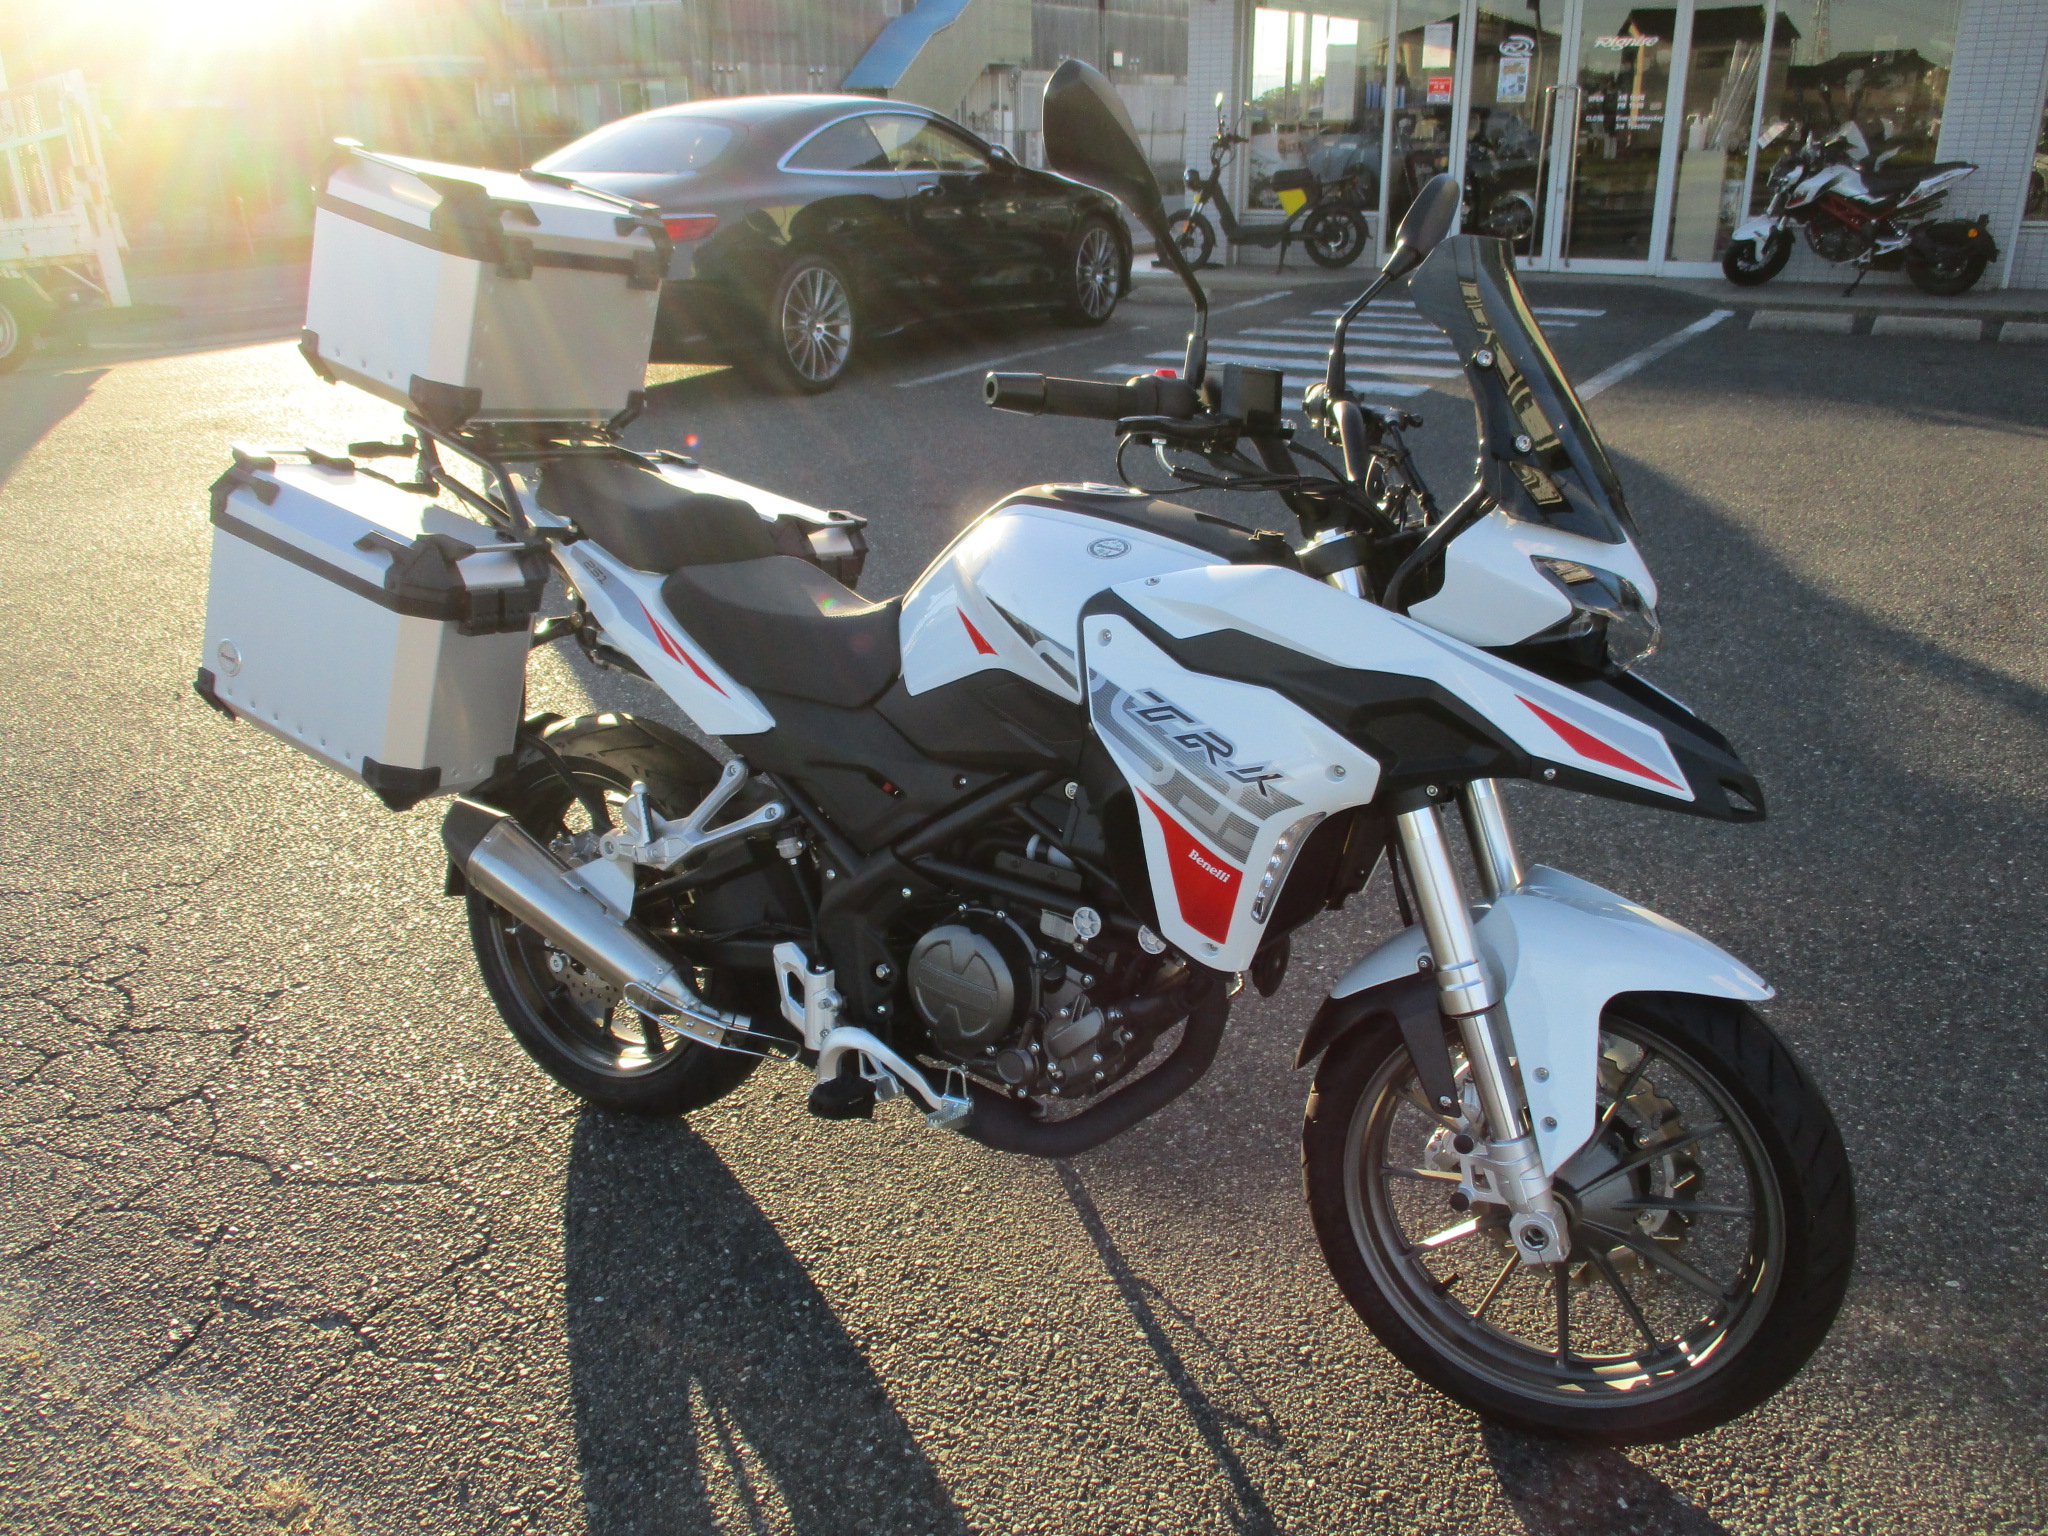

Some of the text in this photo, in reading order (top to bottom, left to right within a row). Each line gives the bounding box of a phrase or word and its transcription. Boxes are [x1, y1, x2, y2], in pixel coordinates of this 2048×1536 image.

[1588, 95, 1604, 103] OPEN
[583, 559, 608, 585] 251
[1136, 690, 1283, 797] TRK
[1187, 848, 1231, 884] Benelli
